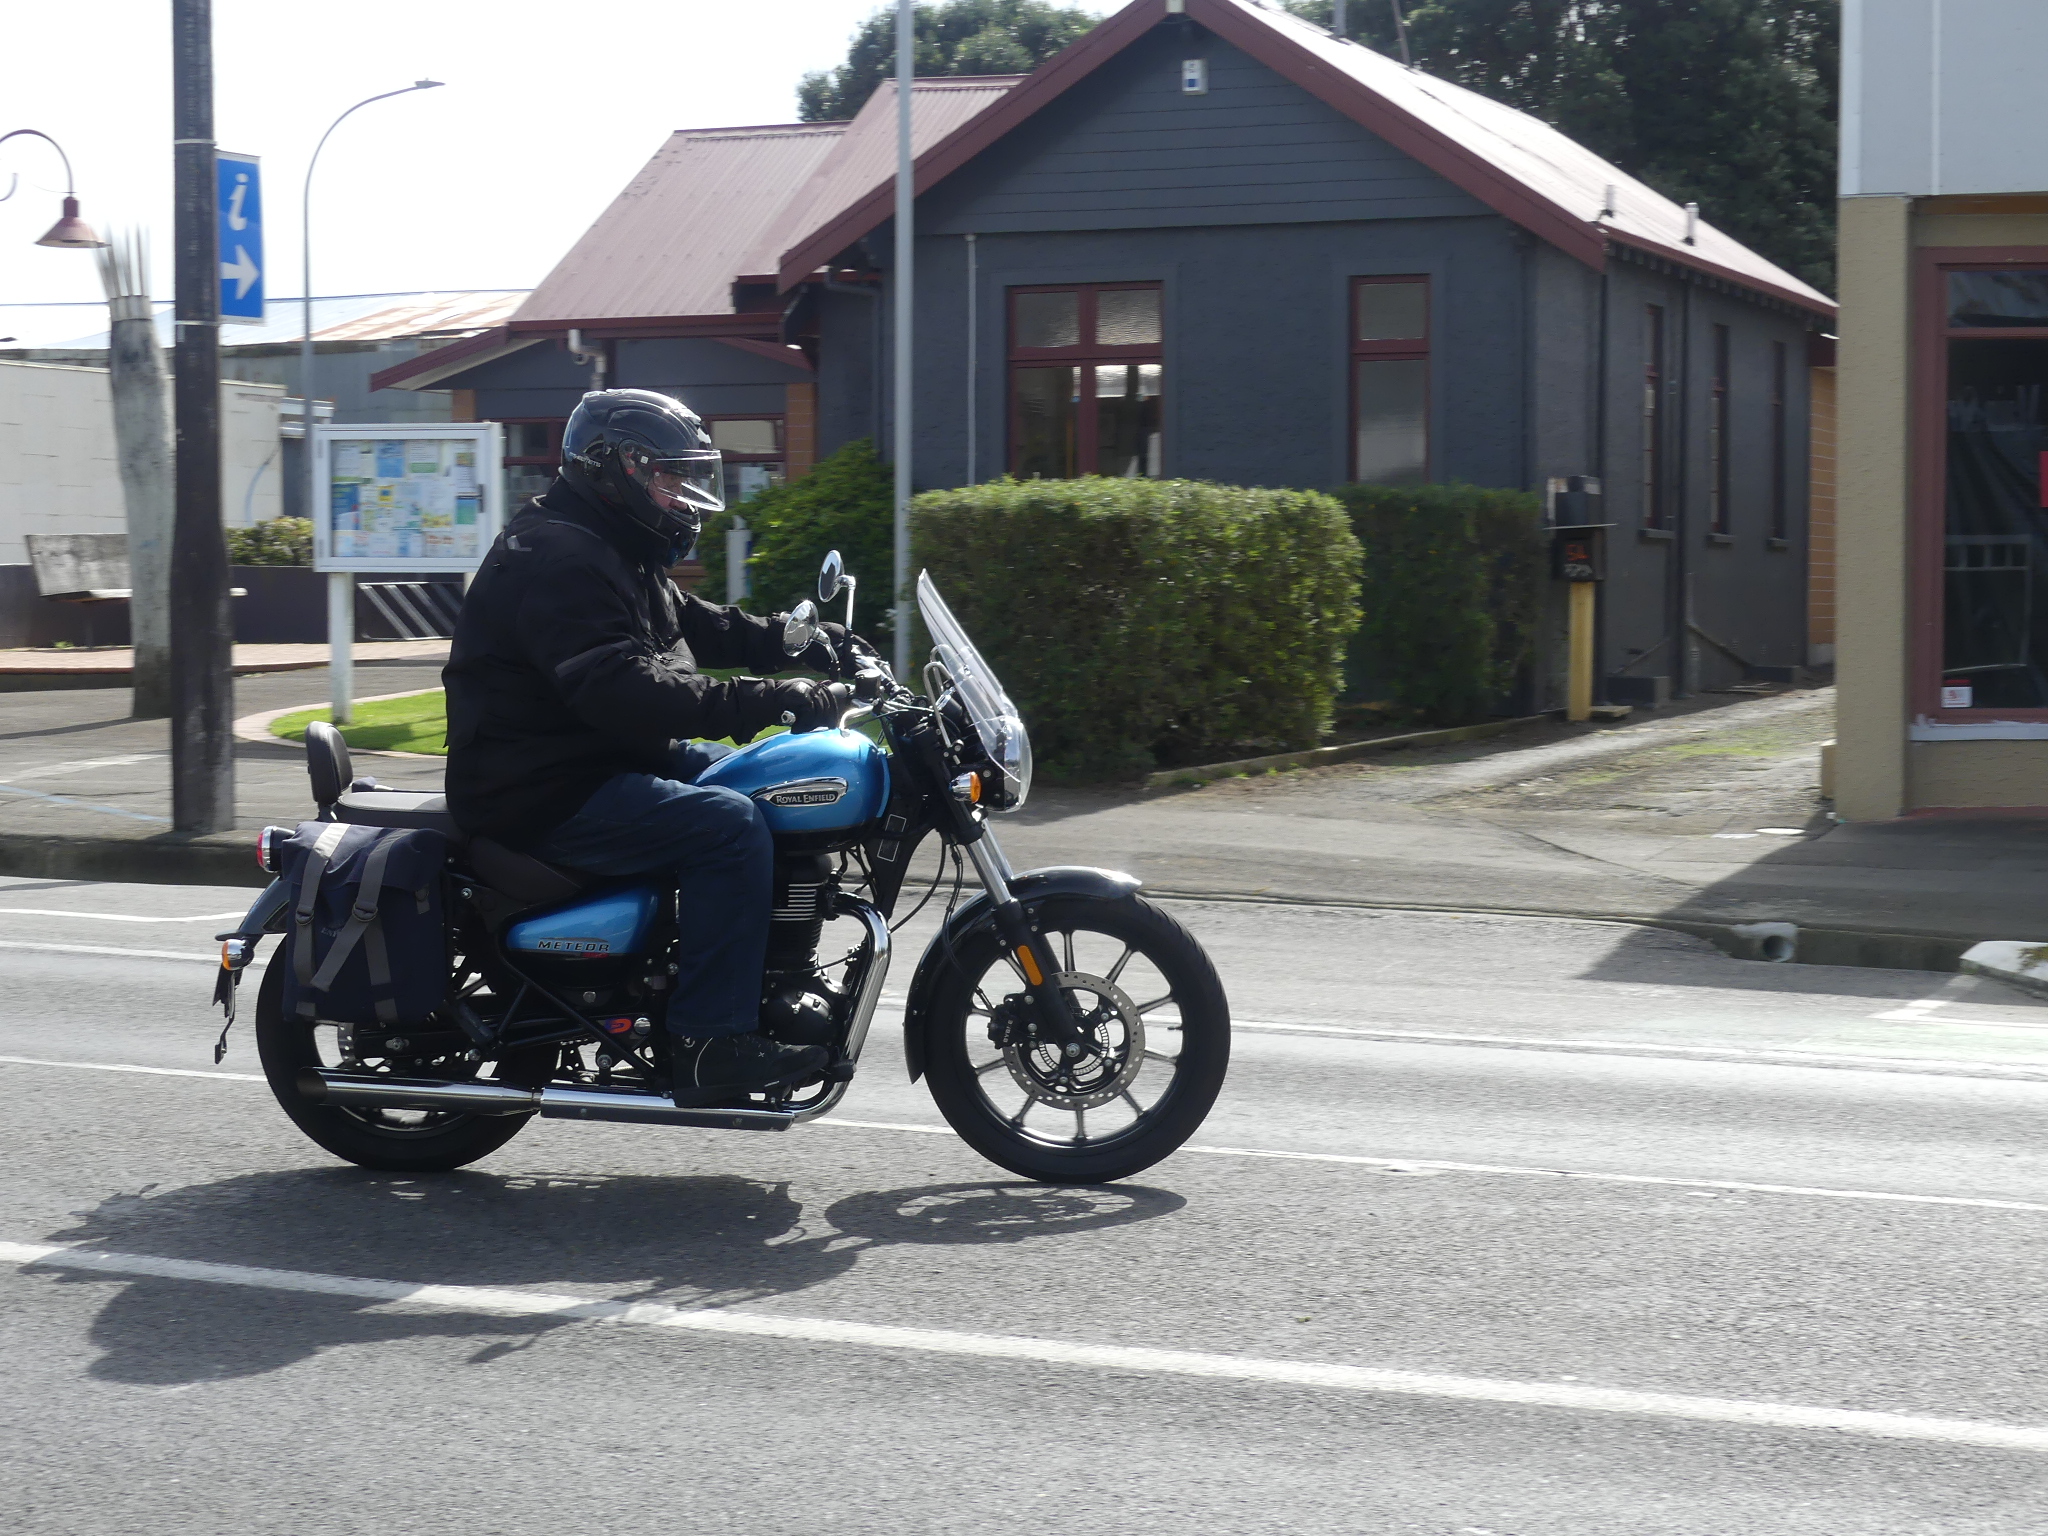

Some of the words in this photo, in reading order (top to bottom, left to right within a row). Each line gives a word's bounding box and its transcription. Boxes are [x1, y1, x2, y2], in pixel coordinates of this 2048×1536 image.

[776, 795, 802, 804] ROYAL
[803, 793, 836, 803] ENFIELD
[538, 941, 610, 952] METEOR
